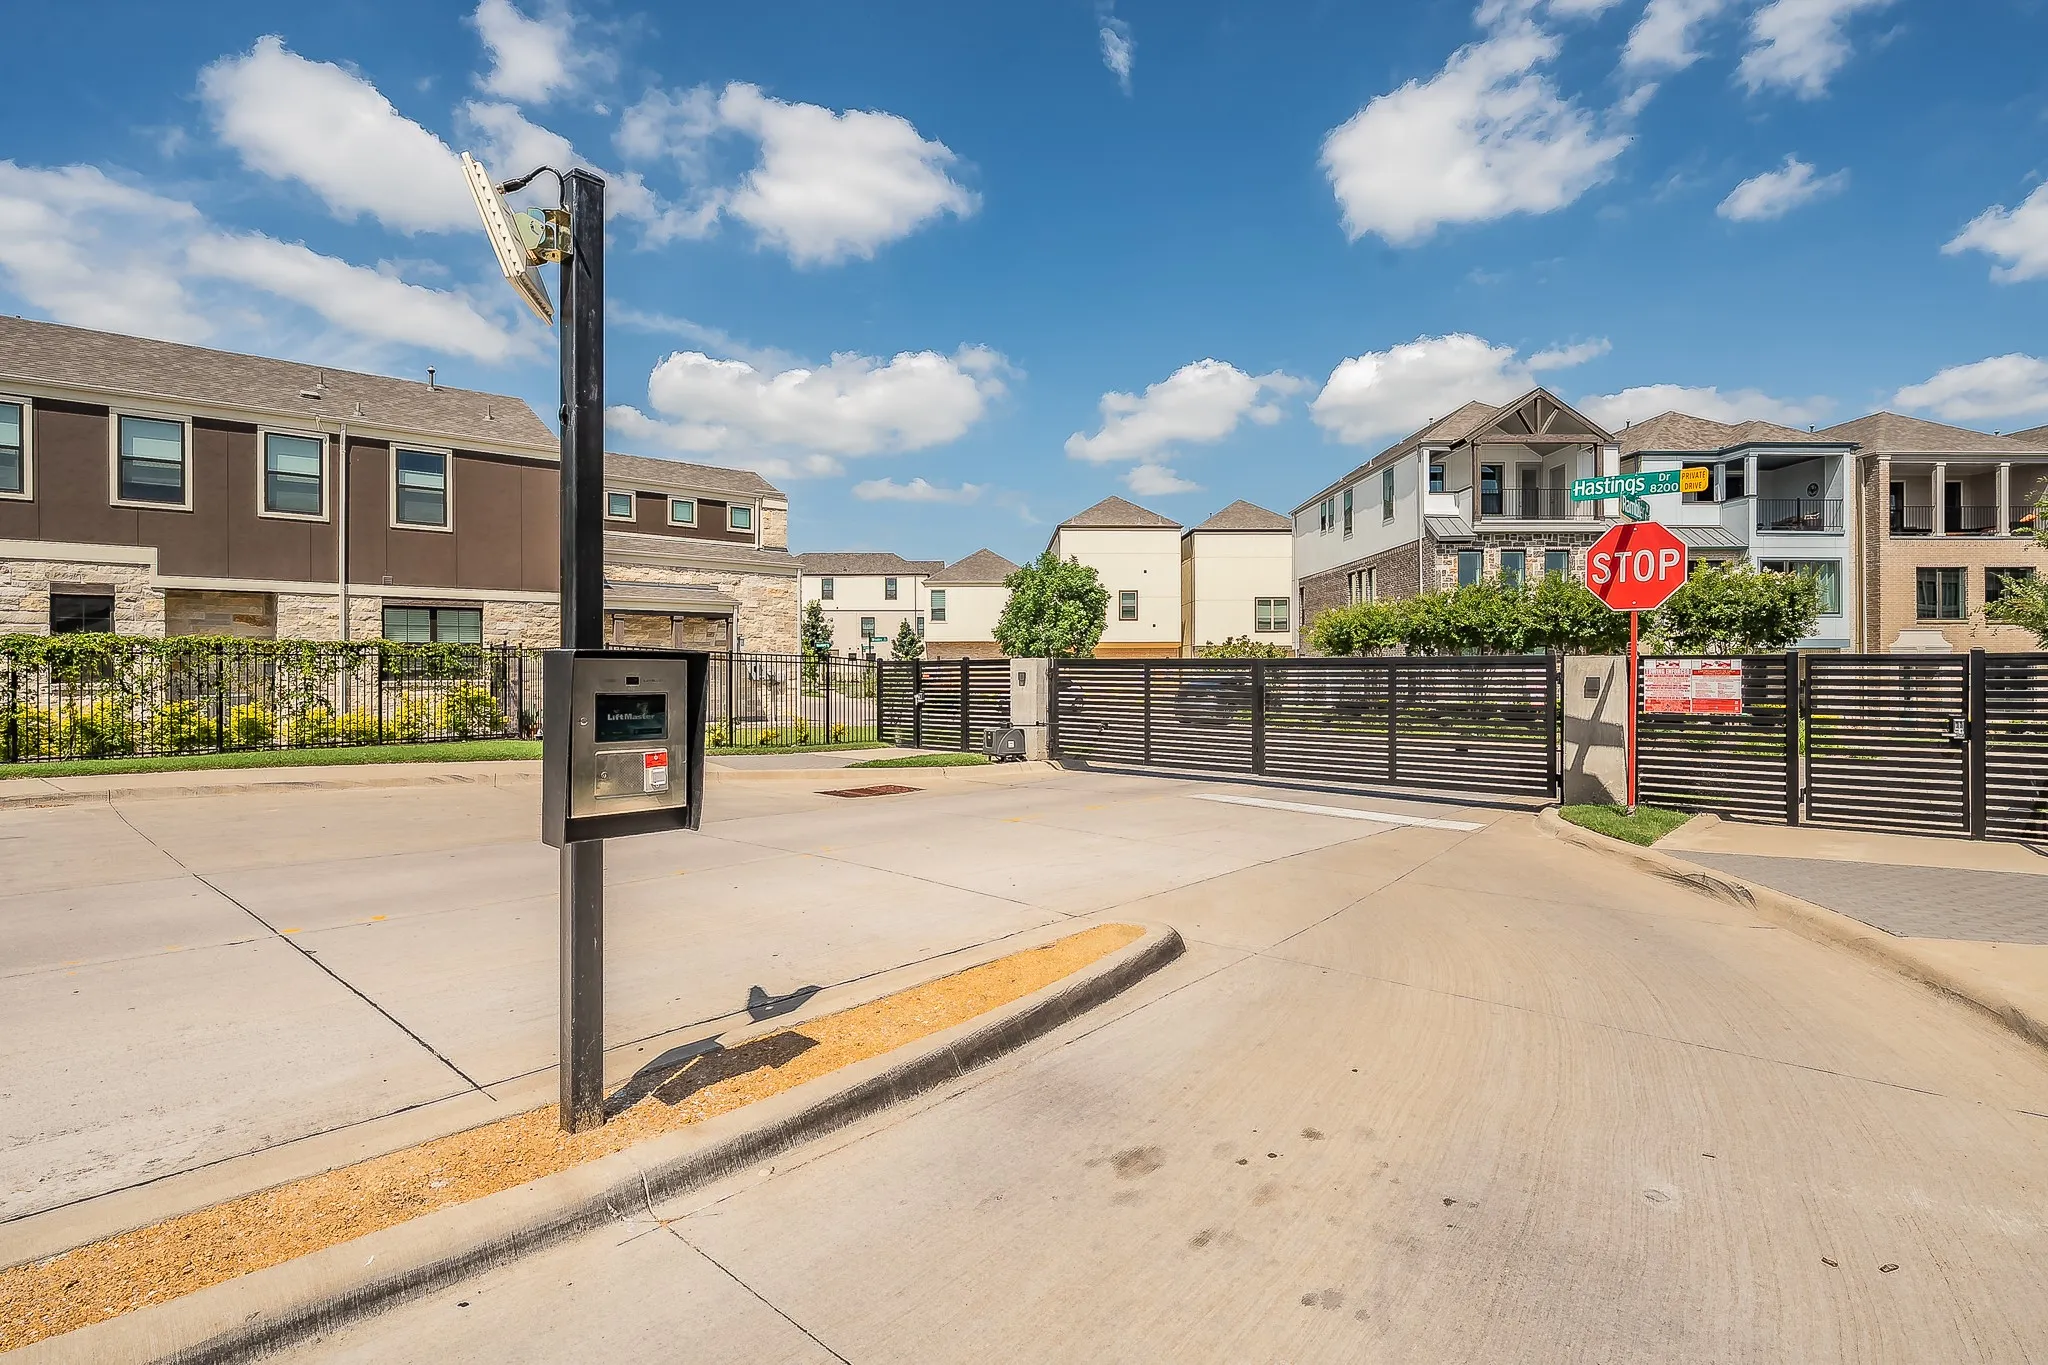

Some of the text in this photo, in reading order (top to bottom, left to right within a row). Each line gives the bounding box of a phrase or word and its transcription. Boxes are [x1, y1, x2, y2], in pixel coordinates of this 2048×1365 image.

[1681, 470, 1706, 480] PRIVATE
[1573, 472, 1671, 497] Hastings Dr
[1650, 482, 1679, 493] 8200
[1684, 481, 1702, 490] DRIVE
[1592, 548, 1680, 584] STOP
[607, 712, 655, 721] LiftMaster
